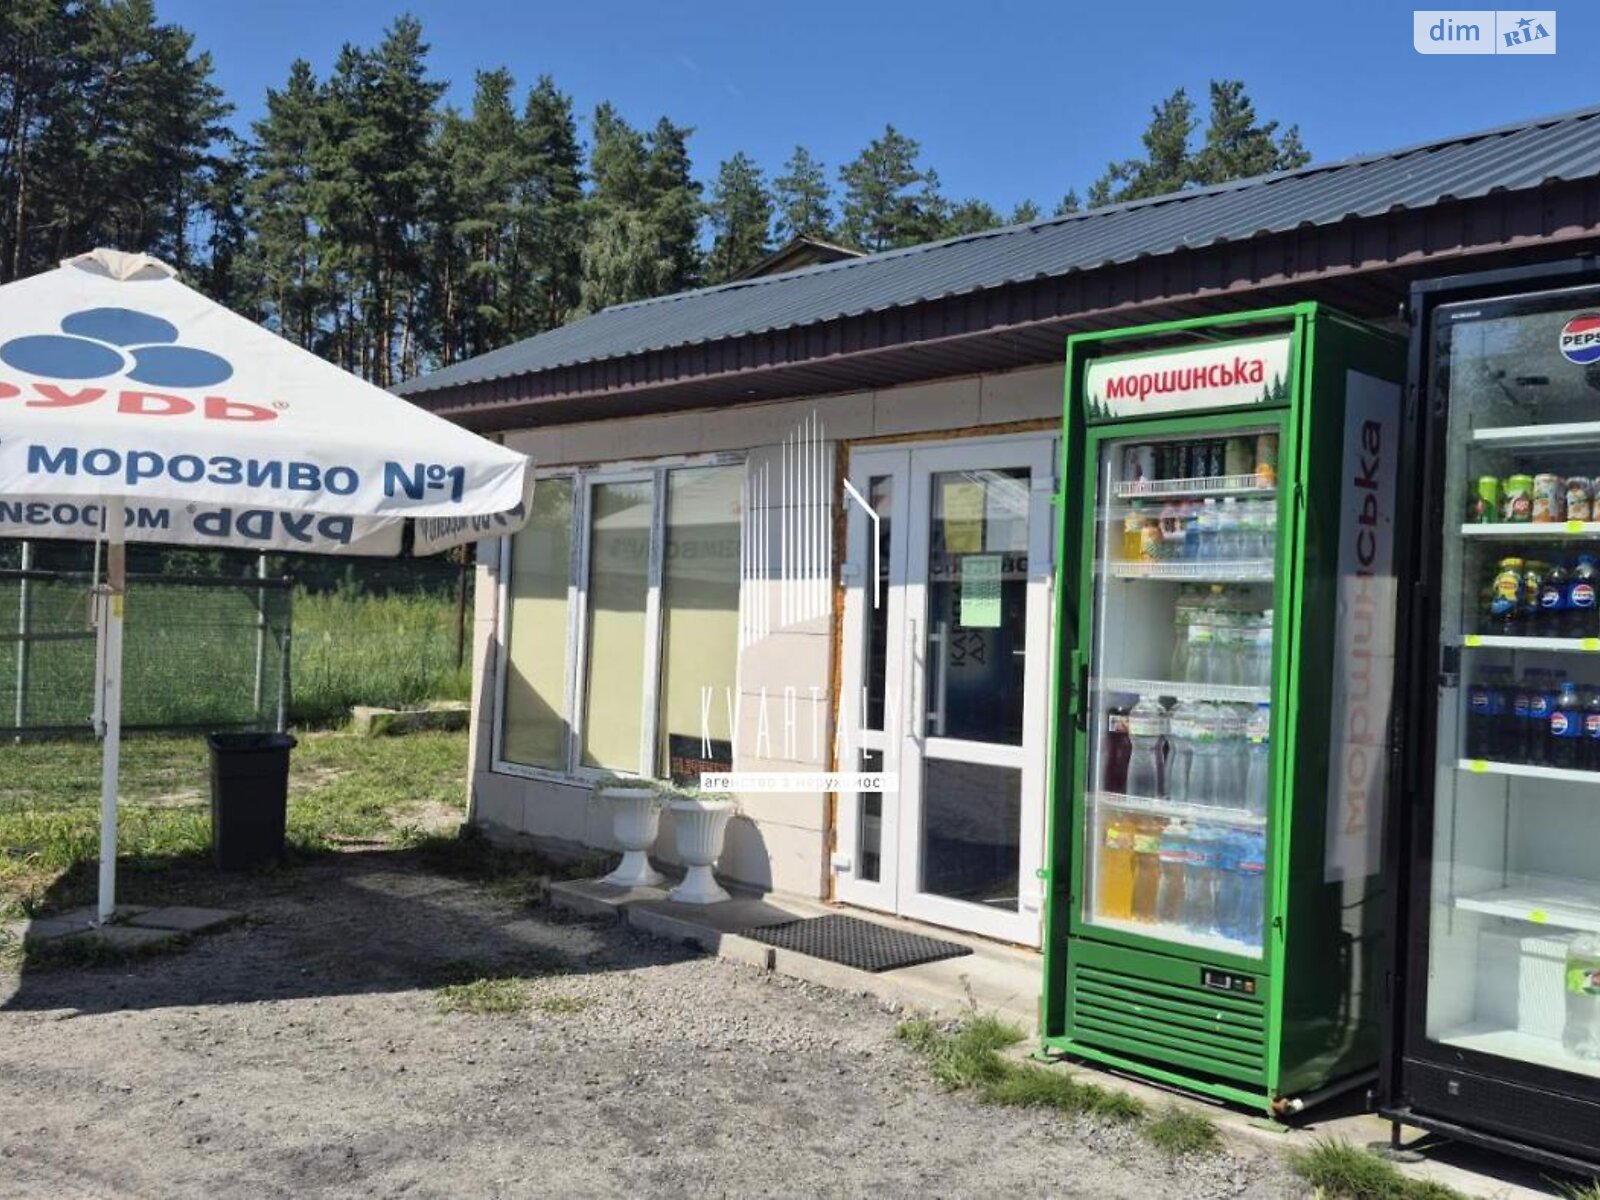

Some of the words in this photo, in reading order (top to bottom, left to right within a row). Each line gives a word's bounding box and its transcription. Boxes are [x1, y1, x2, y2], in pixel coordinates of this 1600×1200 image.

[1106, 356, 1265, 402] моршинська
[27, 444, 360, 496] морозиво
[384, 461, 466, 503] №1
